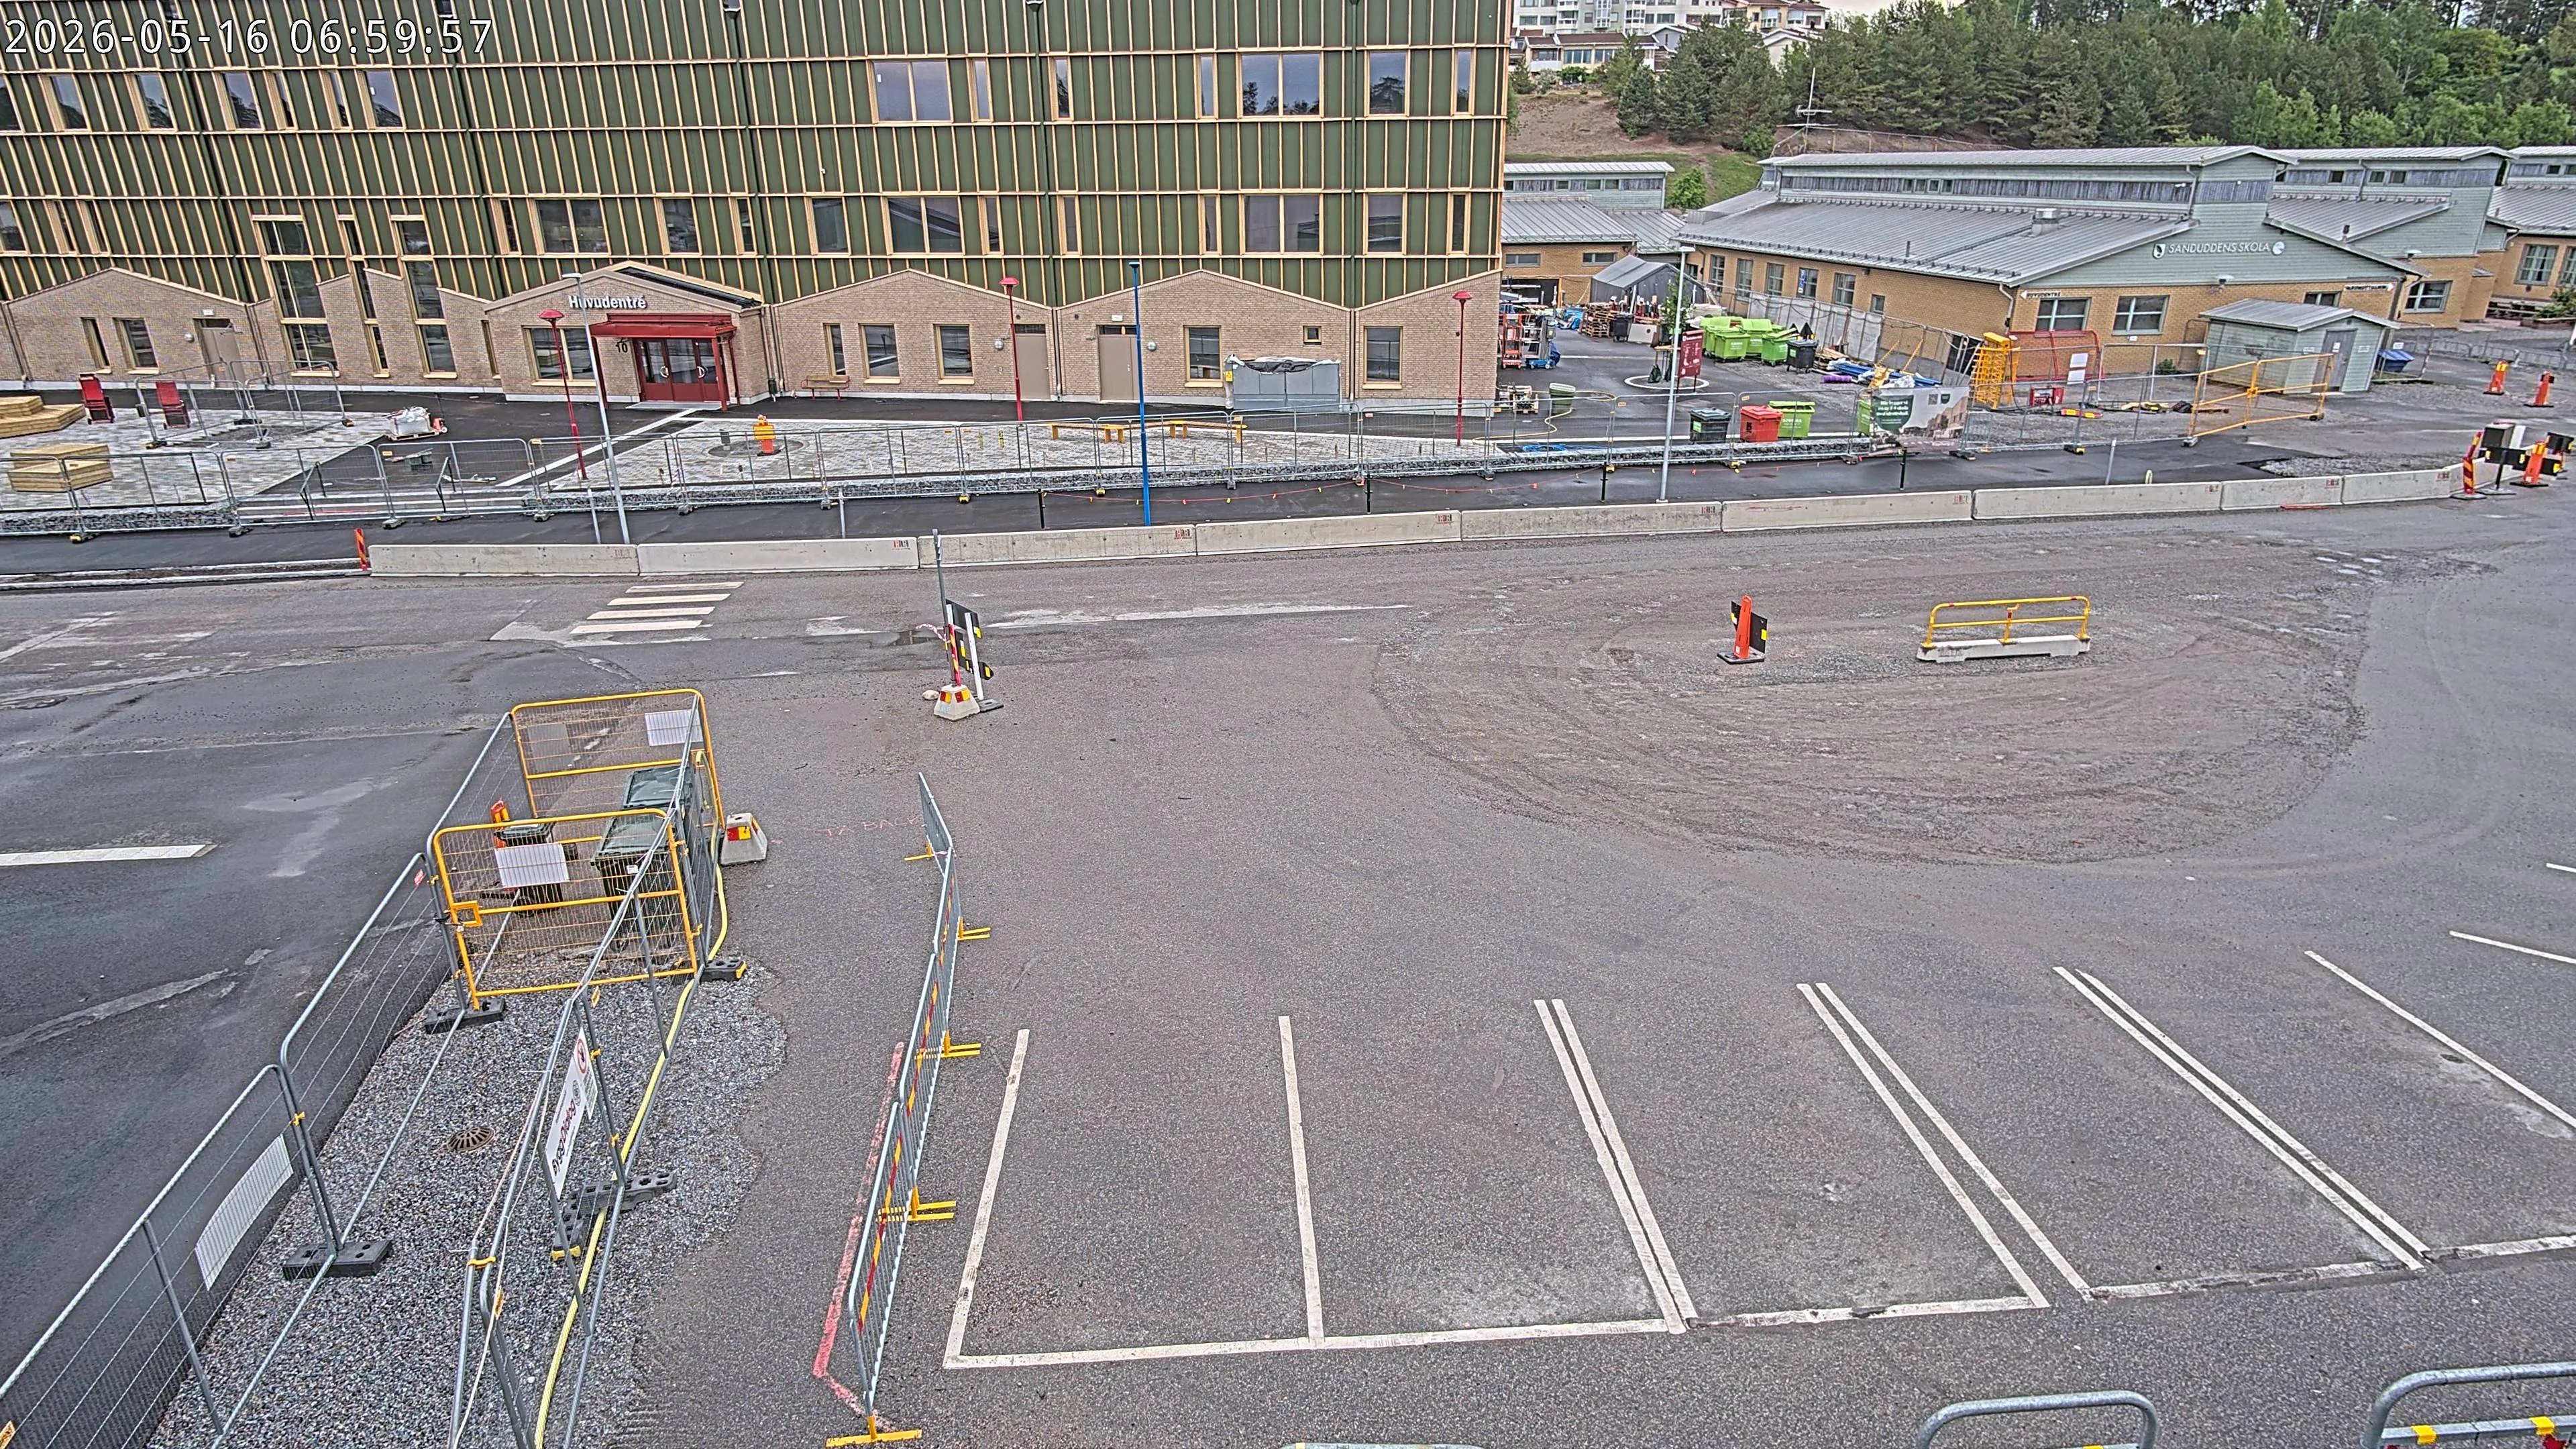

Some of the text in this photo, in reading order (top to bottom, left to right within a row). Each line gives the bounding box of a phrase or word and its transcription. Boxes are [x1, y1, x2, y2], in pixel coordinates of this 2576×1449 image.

[2168, 242, 2269, 254] SANDUDDENS SKOLA
[616, 343, 628, 353] 10
